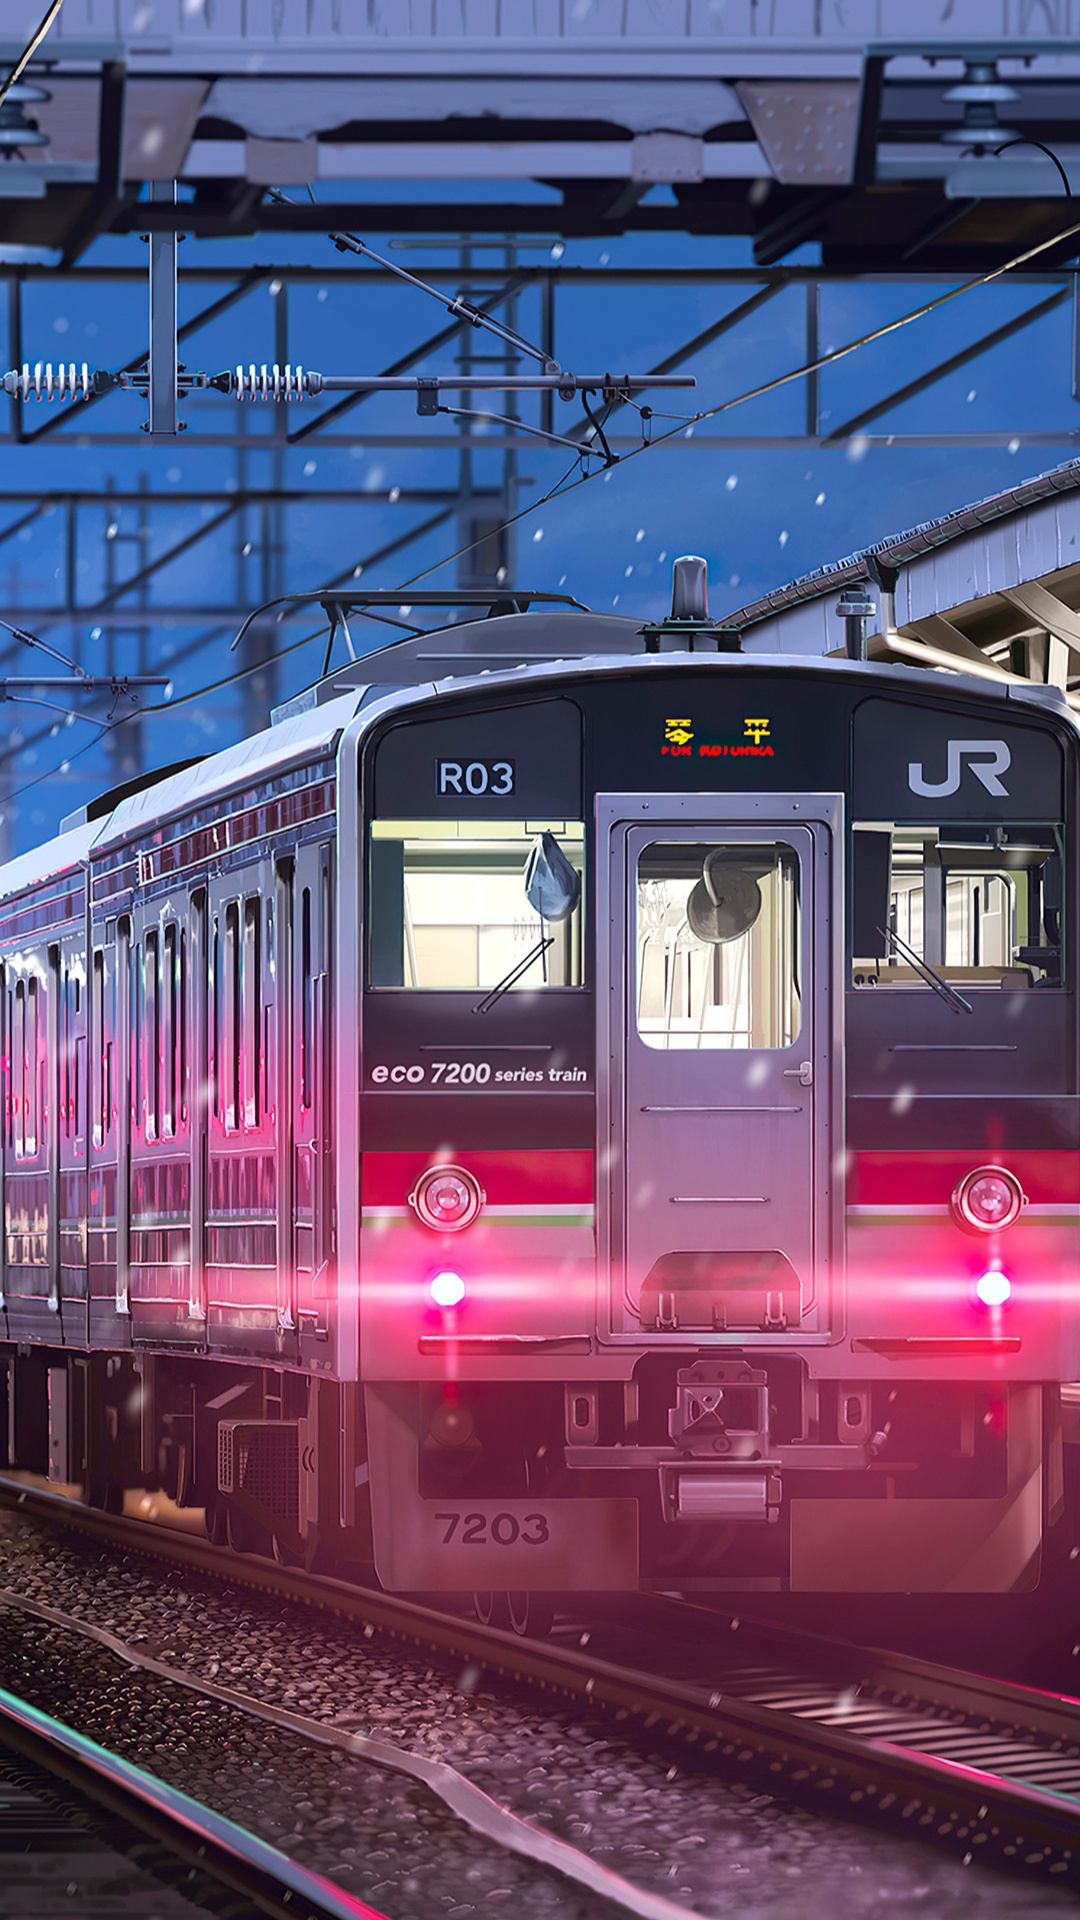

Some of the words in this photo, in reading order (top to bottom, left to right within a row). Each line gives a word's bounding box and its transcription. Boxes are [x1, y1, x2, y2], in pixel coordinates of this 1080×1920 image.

[440, 762, 513, 795] R03
[908, 740, 1011, 797] JR
[371, 1064, 425, 1083] eco
[430, 1062, 491, 1084] 7200
[495, 1067, 544, 1082] series
[548, 1067, 587, 1082] train
[434, 1513, 549, 1546] 7203
